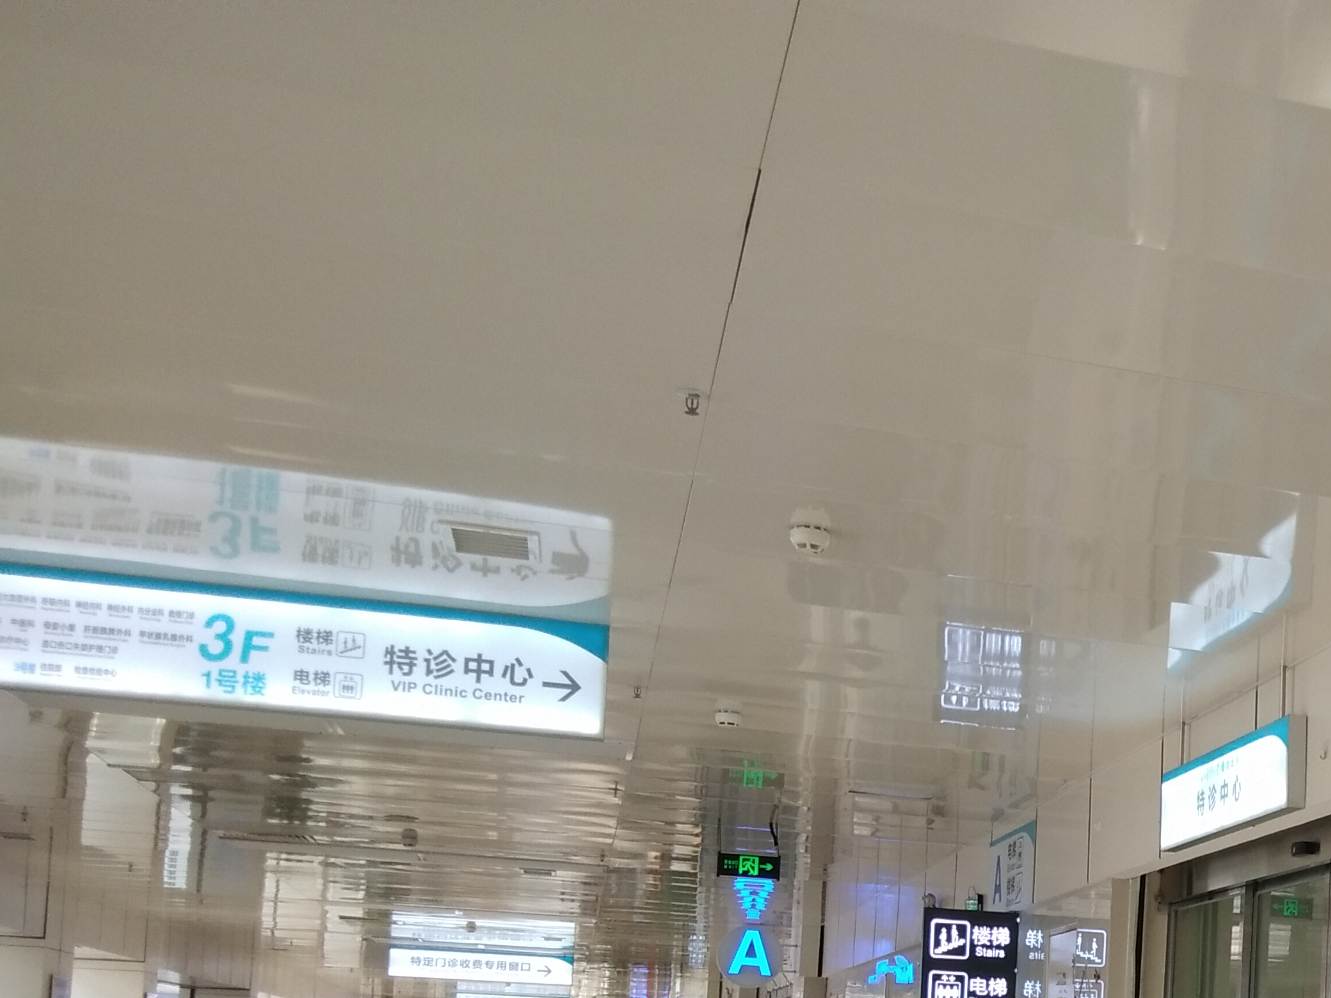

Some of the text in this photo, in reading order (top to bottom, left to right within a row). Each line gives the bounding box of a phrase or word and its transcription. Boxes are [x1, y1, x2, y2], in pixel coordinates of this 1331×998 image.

[198, 613, 275, 664] 3F
[296, 627, 334, 646] 楼梯
[297, 645, 333, 656] Stairs
[384, 645, 534, 687] 特诊中心
[202, 668, 266, 695] 1号楼
[293, 669, 331, 687] 电梯
[291, 685, 330, 697] Elevator
[391, 680, 525, 704] VIP Clinic Center
[1197, 775, 1242, 816] 特诊中心
[972, 925, 1011, 947] 楼梯
[728, 930, 772, 976] A
[975, 946, 1005, 959] Stairs
[410, 955, 531, 972] 特定门诊收费专用窗口
[969, 976, 1008, 997] 电梯
